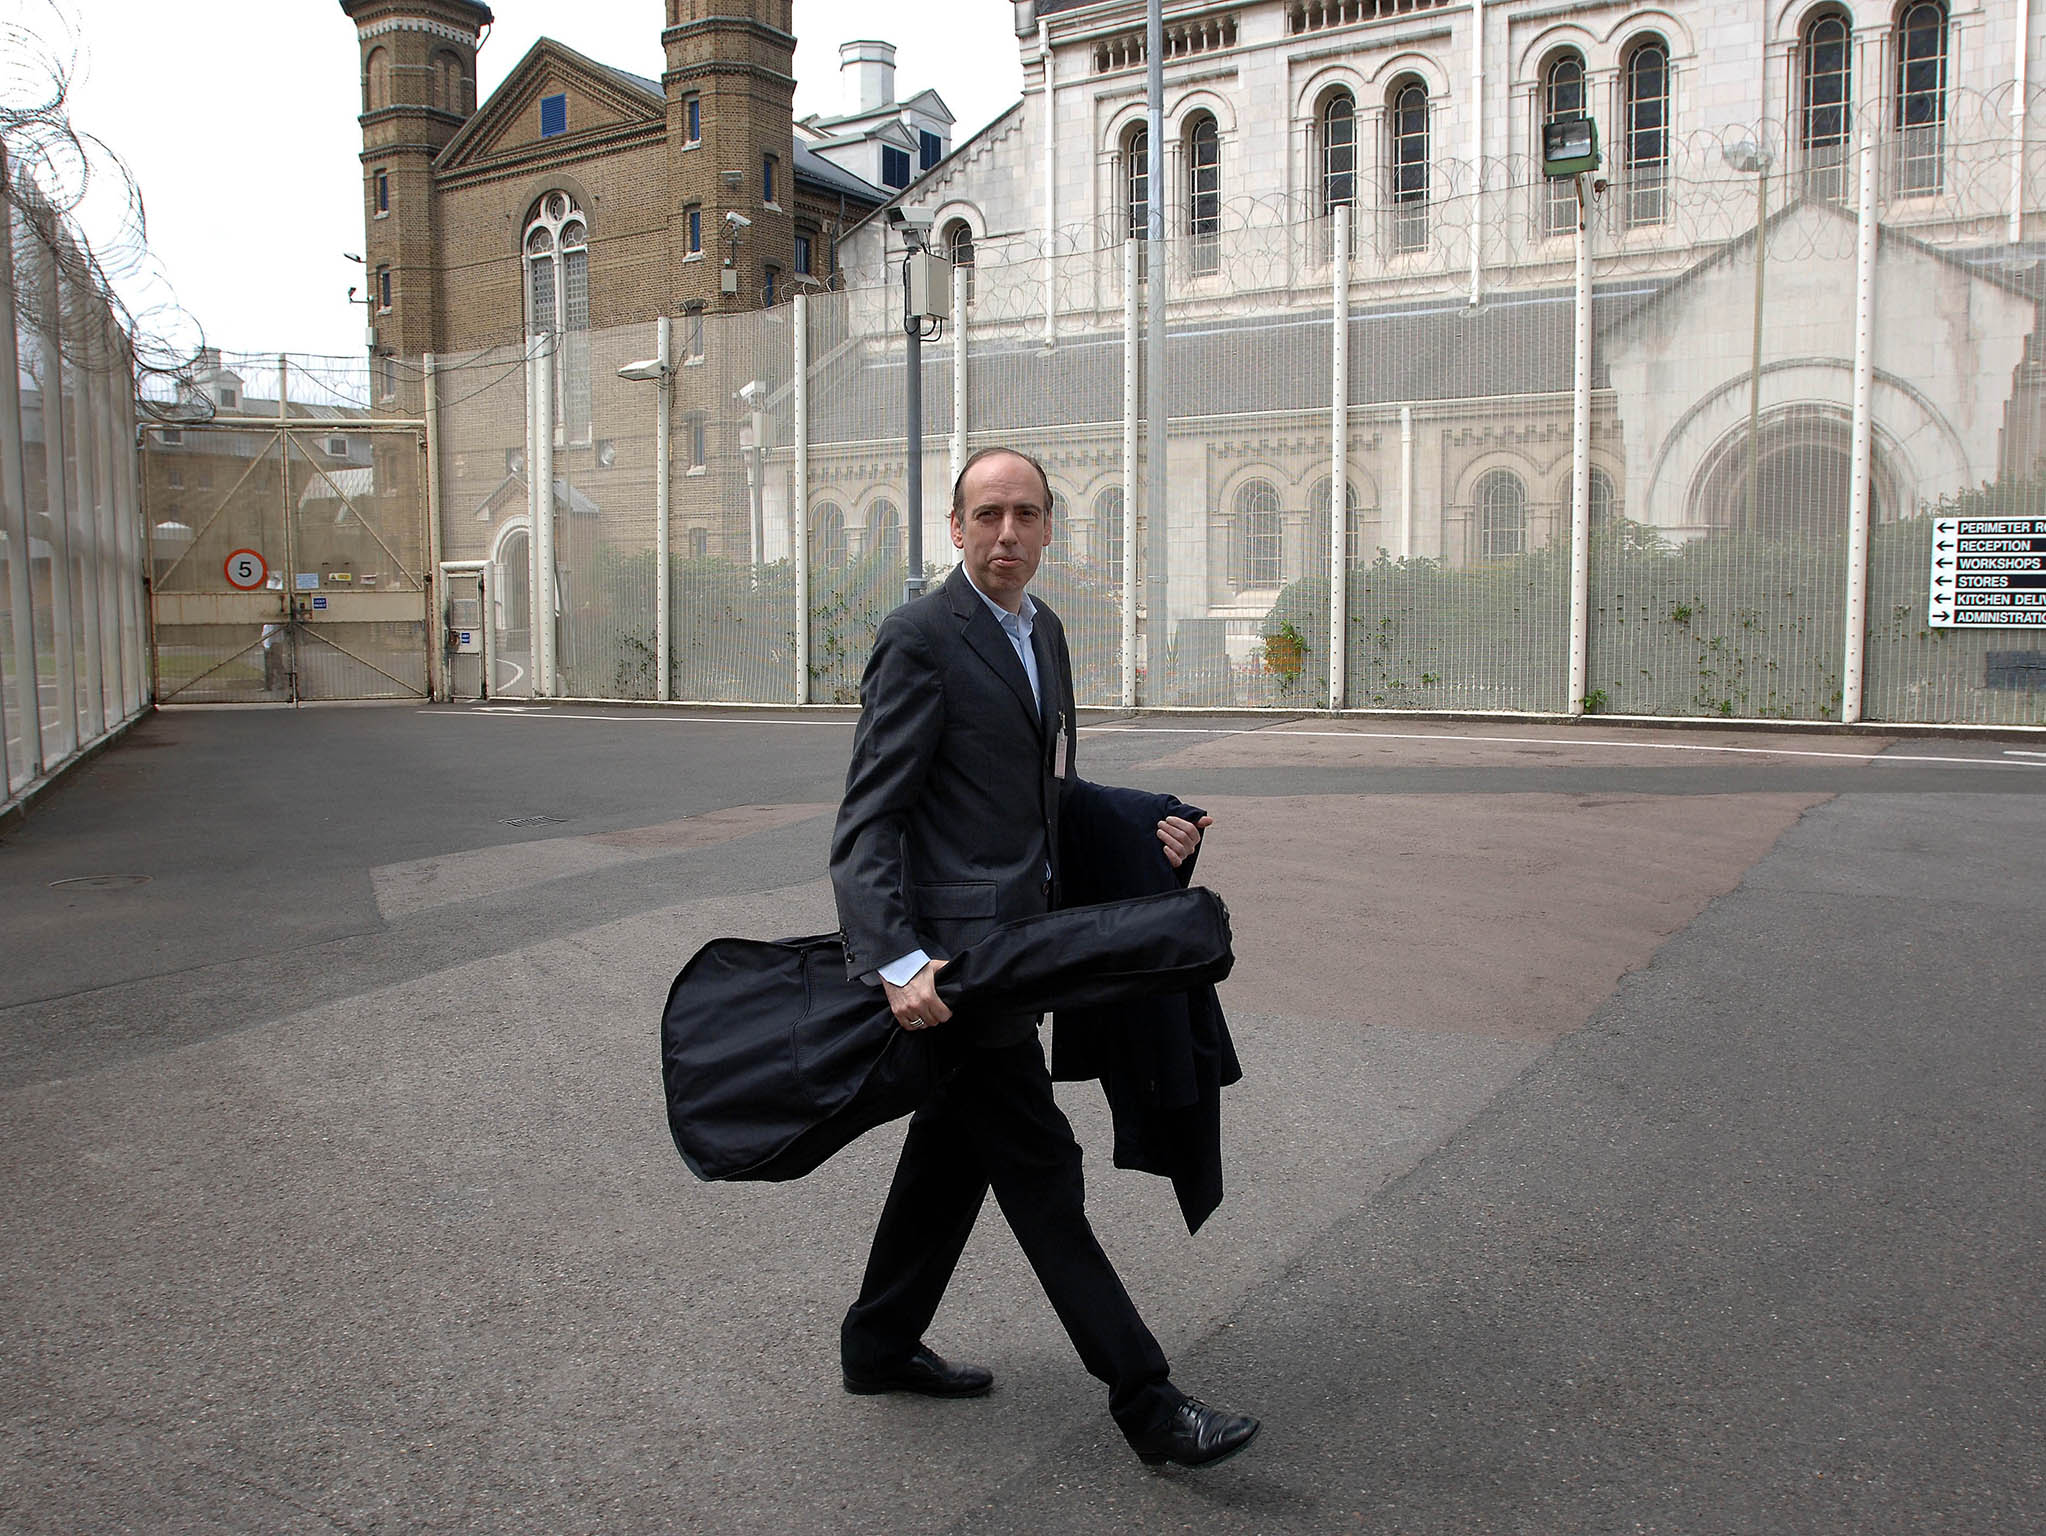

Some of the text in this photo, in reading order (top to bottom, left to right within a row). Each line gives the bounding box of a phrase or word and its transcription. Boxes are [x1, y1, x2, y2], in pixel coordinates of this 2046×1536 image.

[1960, 521, 2046, 533] PERIMETER R
[1960, 540, 2031, 552] RECEPTION
[1960, 558, 2041, 569] WORKSHOPS
[238, 561, 252, 578] 5
[1958, 576, 2009, 587] STORES
[1957, 594, 2011, 605] KITCHEN
